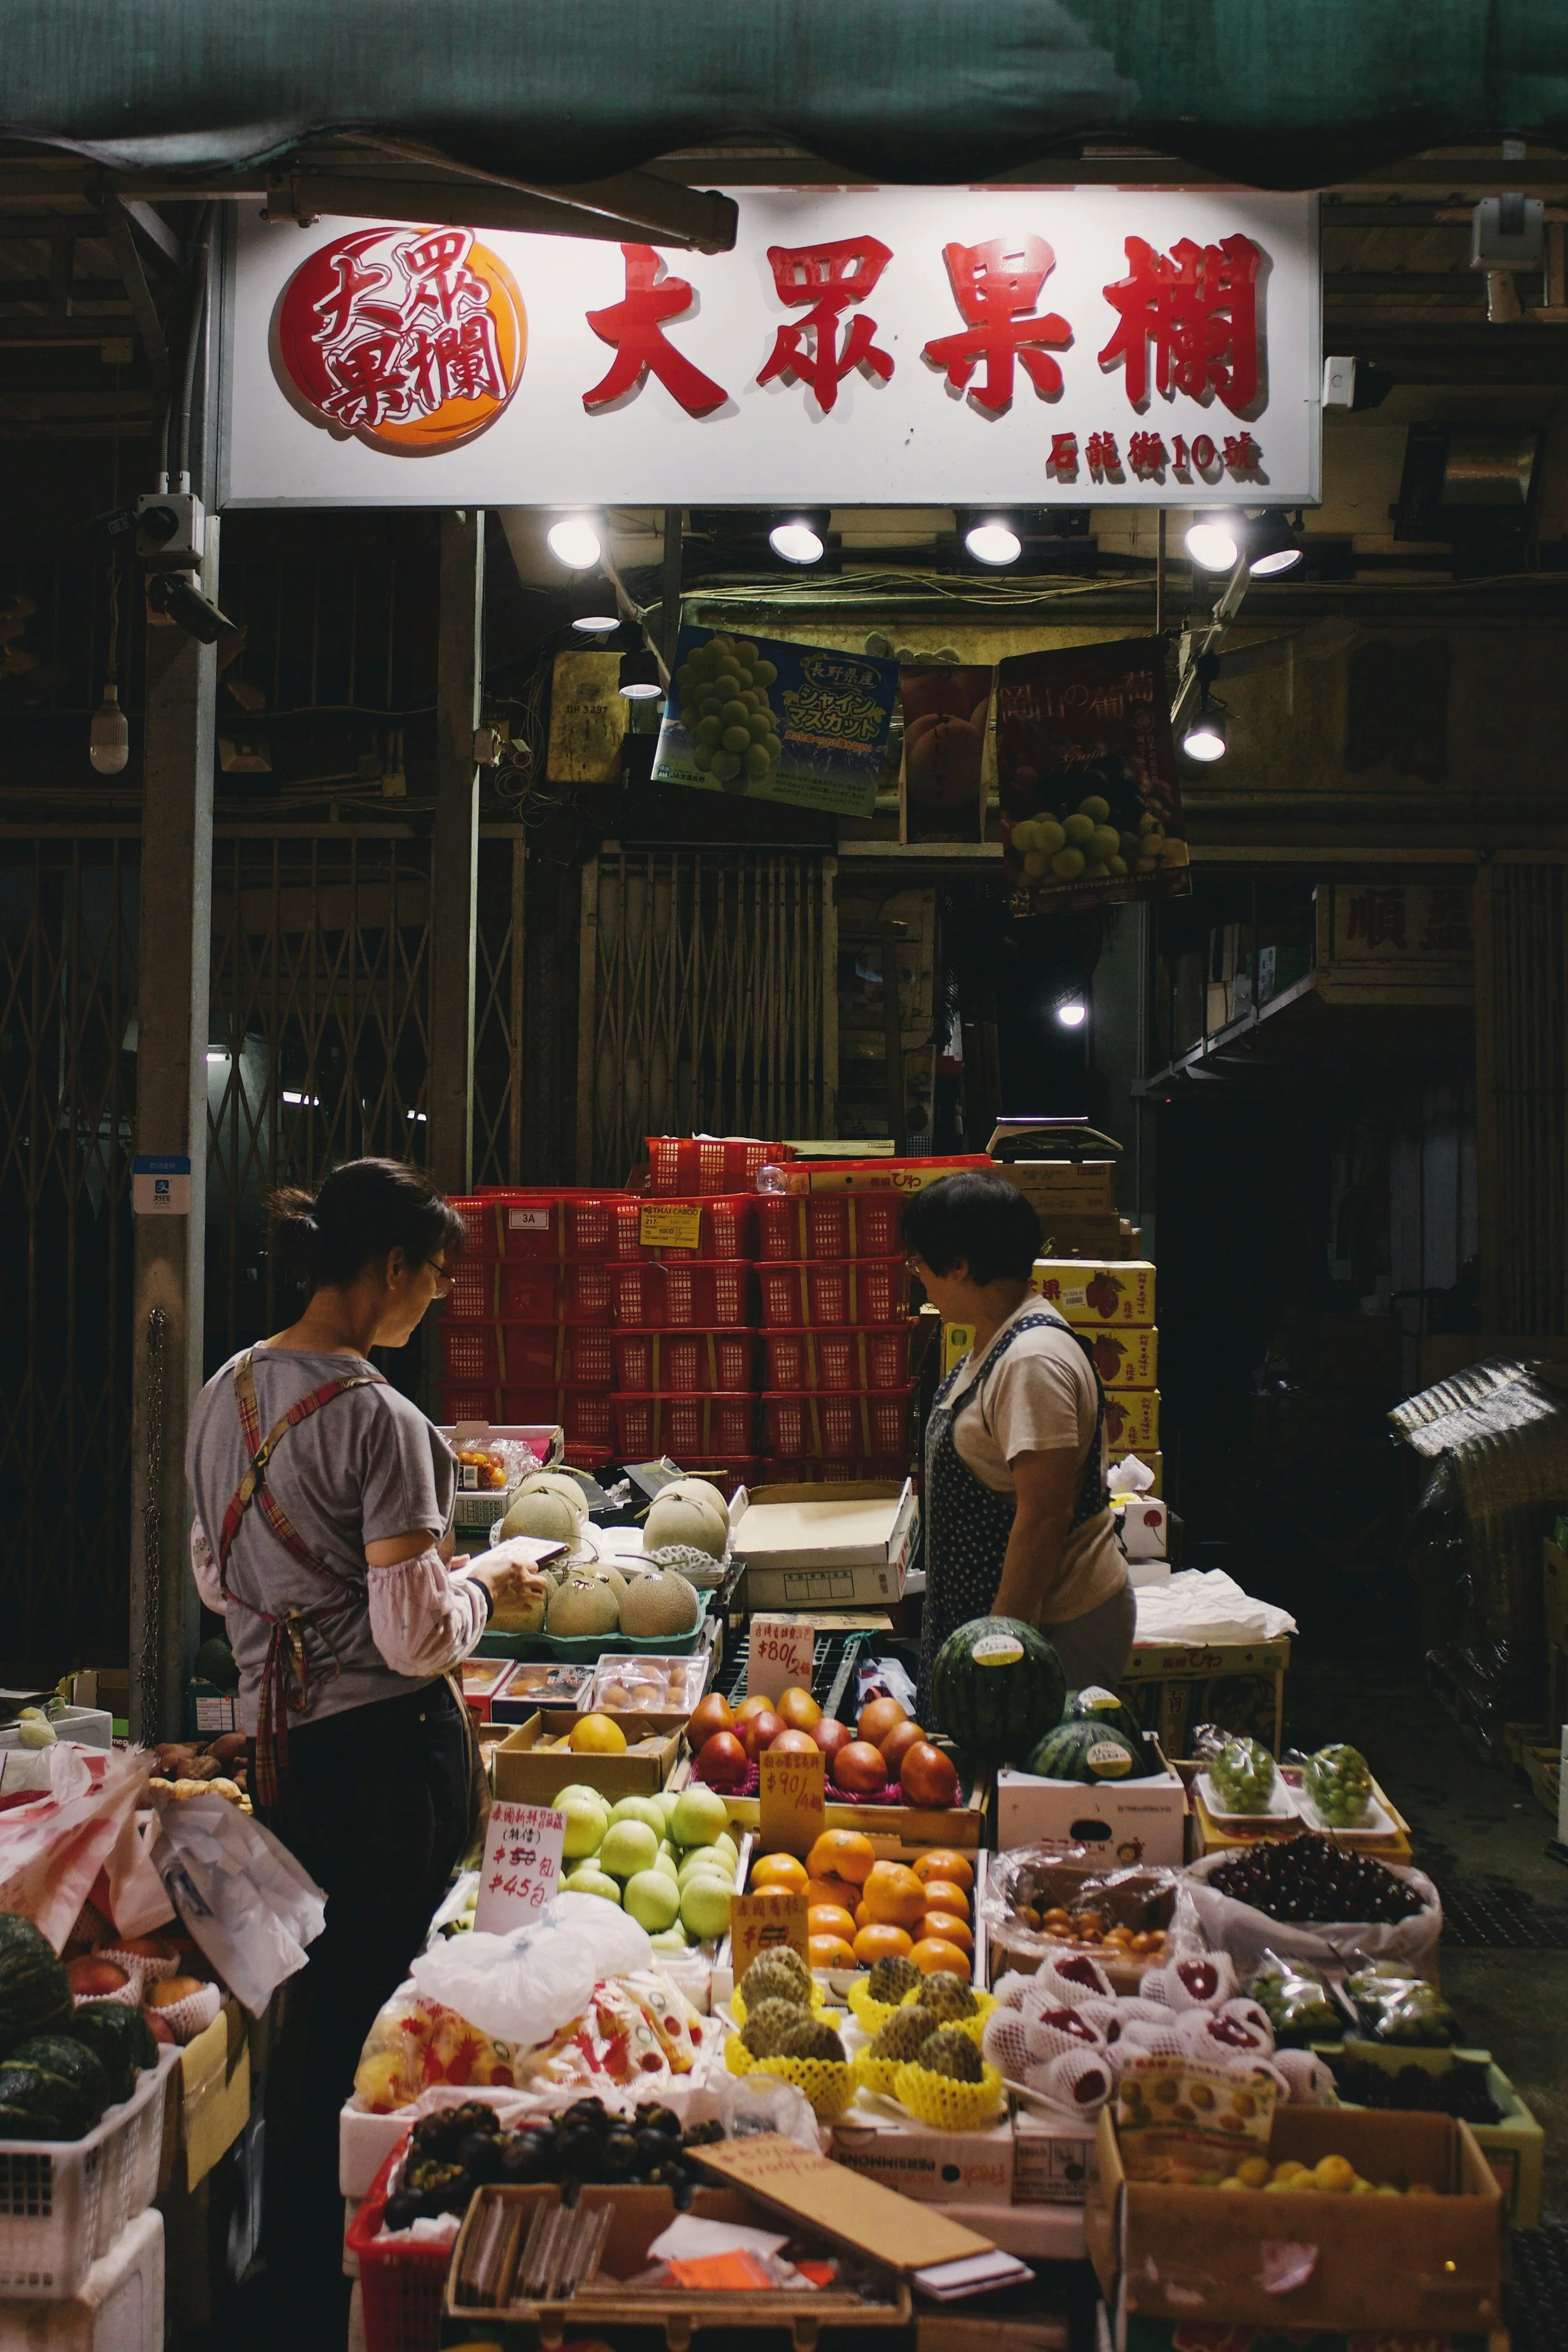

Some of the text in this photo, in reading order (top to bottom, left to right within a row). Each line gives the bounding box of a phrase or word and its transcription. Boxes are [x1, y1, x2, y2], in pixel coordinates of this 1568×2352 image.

[583, 233, 1261, 411] 大眾果欄
[1046, 431, 1259, 470] 石龍街10號
[811, 662, 874, 686] 長野県産
[583, 705, 608, 714] 3297
[798, 684, 875, 716] シャイン
[1000, 670, 1153, 723] 岡山の葡萄
[787, 706, 880, 740] マスカット
[522, 1214, 536, 1223] 3A
[653, 1207, 698, 1216] THAI CARGO
